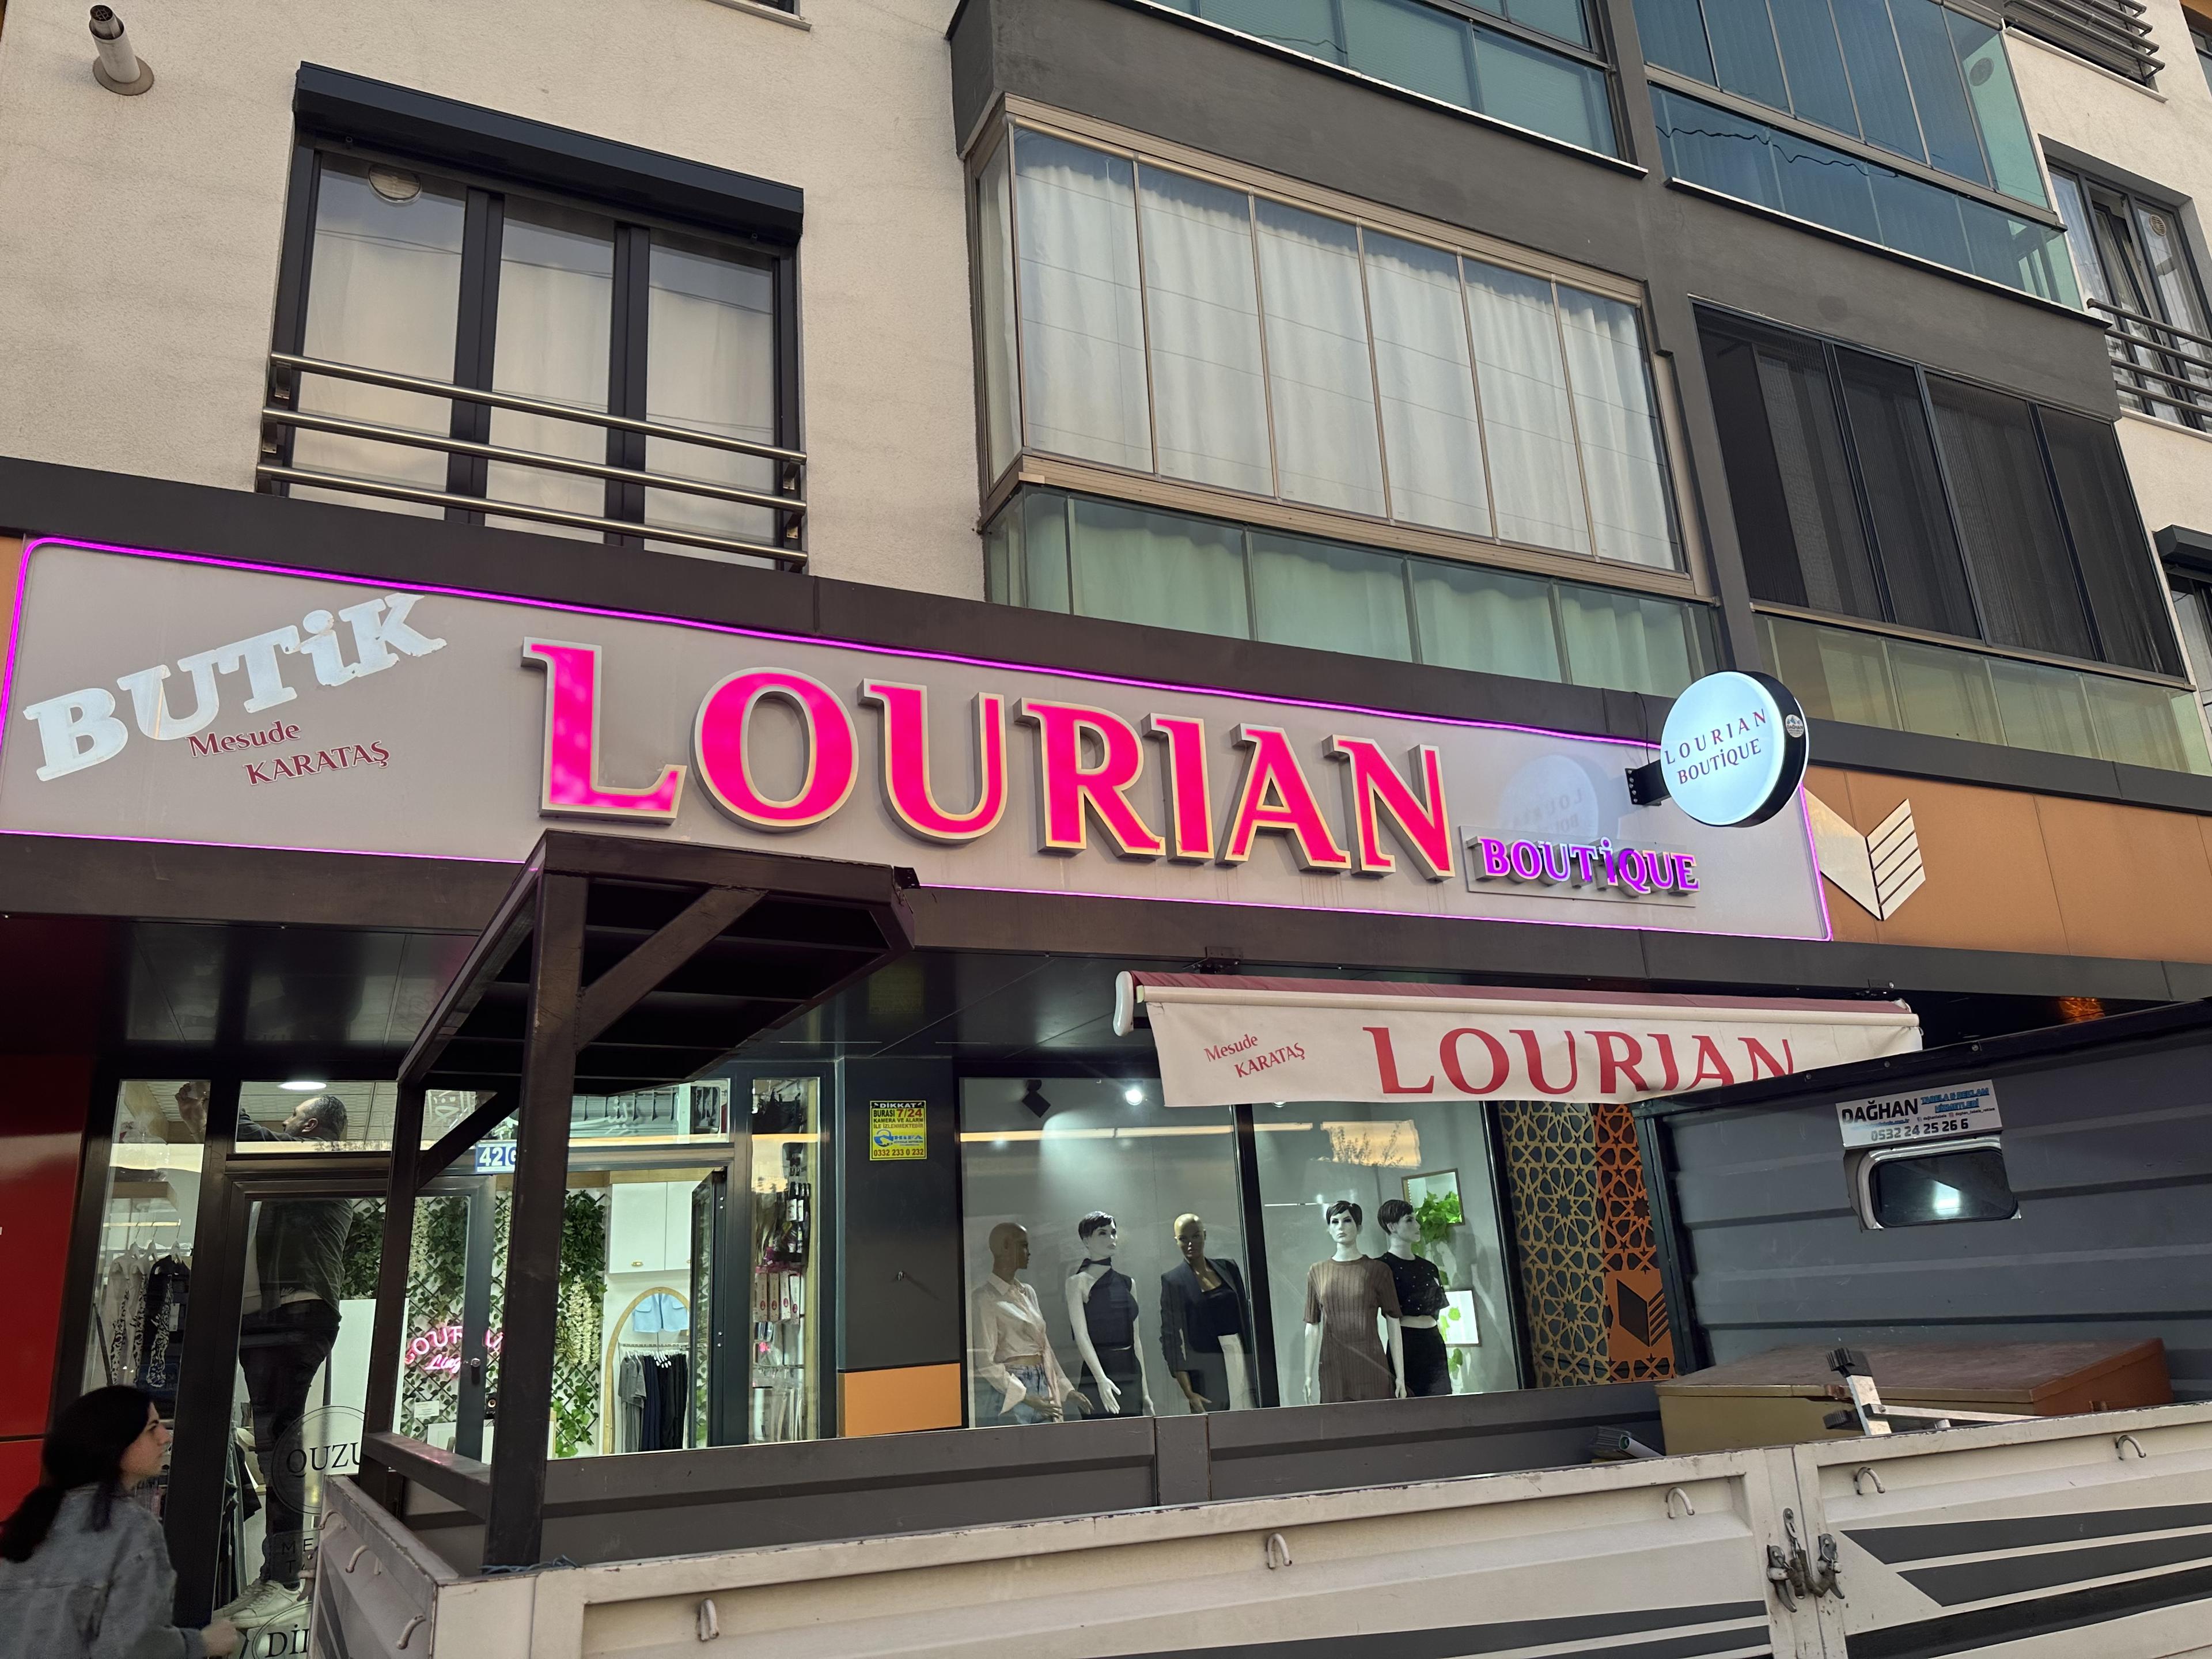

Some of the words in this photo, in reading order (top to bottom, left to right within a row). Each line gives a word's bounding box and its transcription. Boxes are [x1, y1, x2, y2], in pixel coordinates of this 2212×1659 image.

[184, 719, 302, 757] Mesude
[1664, 709, 1766, 764] LOURIAN
[243, 740, 390, 786] KARATAŞ
[521, 636, 1456, 881] LOURIAN
[1677, 738, 1761, 784] BOUTİQUE
[1203, 1034, 1258, 1062] Mesude
[1233, 1043, 1305, 1078] KARATAŞ
[1362, 1027, 1794, 1094] LOURIAN
[873, 1109, 895, 1118] BURASI
[896, 1108, 922, 1118] 7/24
[1842, 1098, 1918, 1124] DAĞHAN
[1871, 1127, 1901, 1141] 0532
[1904, 1124, 1920, 1137] 24
[1924, 1122, 1939, 1134] 25
[1942, 1120, 1957, 1132] 26
[1961, 1118, 1968, 1129] 6
[479, 1147, 503, 1166] 42
